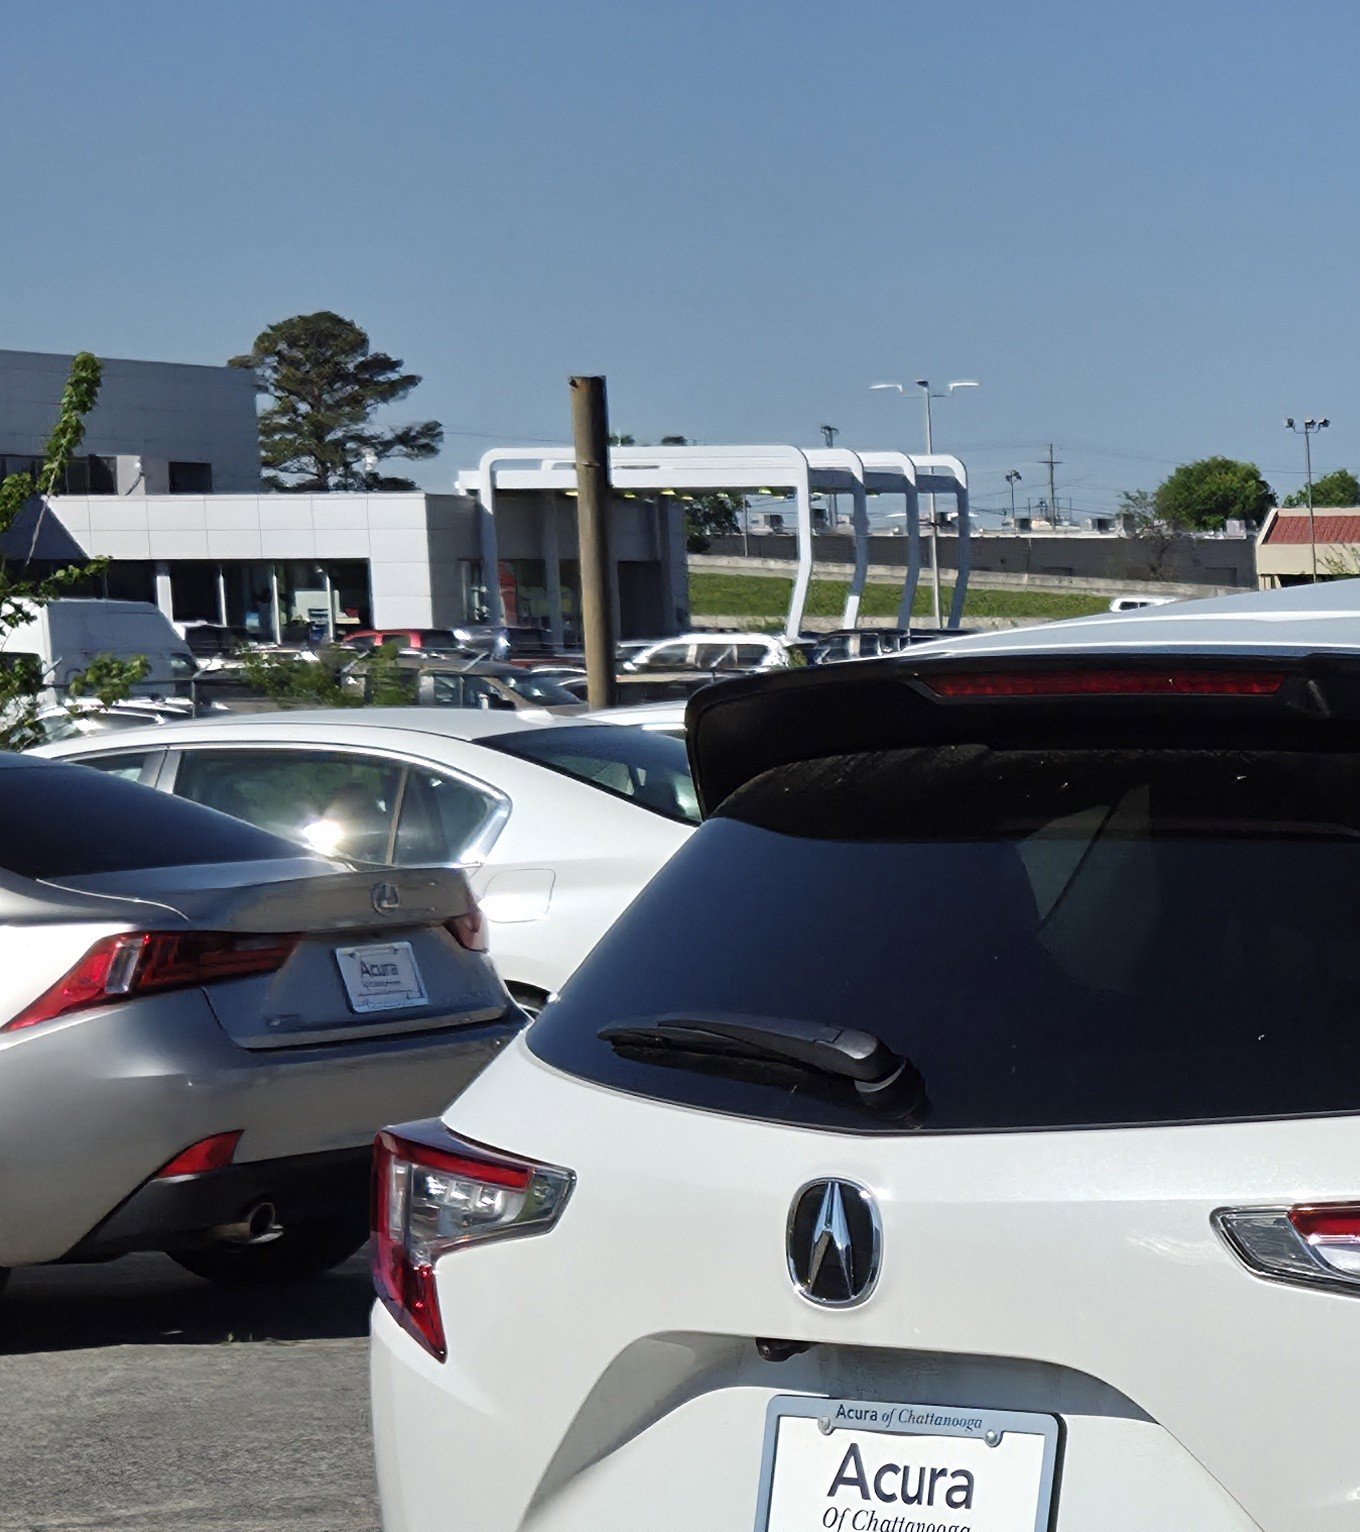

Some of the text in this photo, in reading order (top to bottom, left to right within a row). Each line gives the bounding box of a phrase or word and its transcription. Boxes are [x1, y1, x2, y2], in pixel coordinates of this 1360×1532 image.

[360, 960, 399, 977] Acura
[835, 1404, 983, 1430] Acura of Chattanooga
[827, 1442, 975, 1510] Acura
